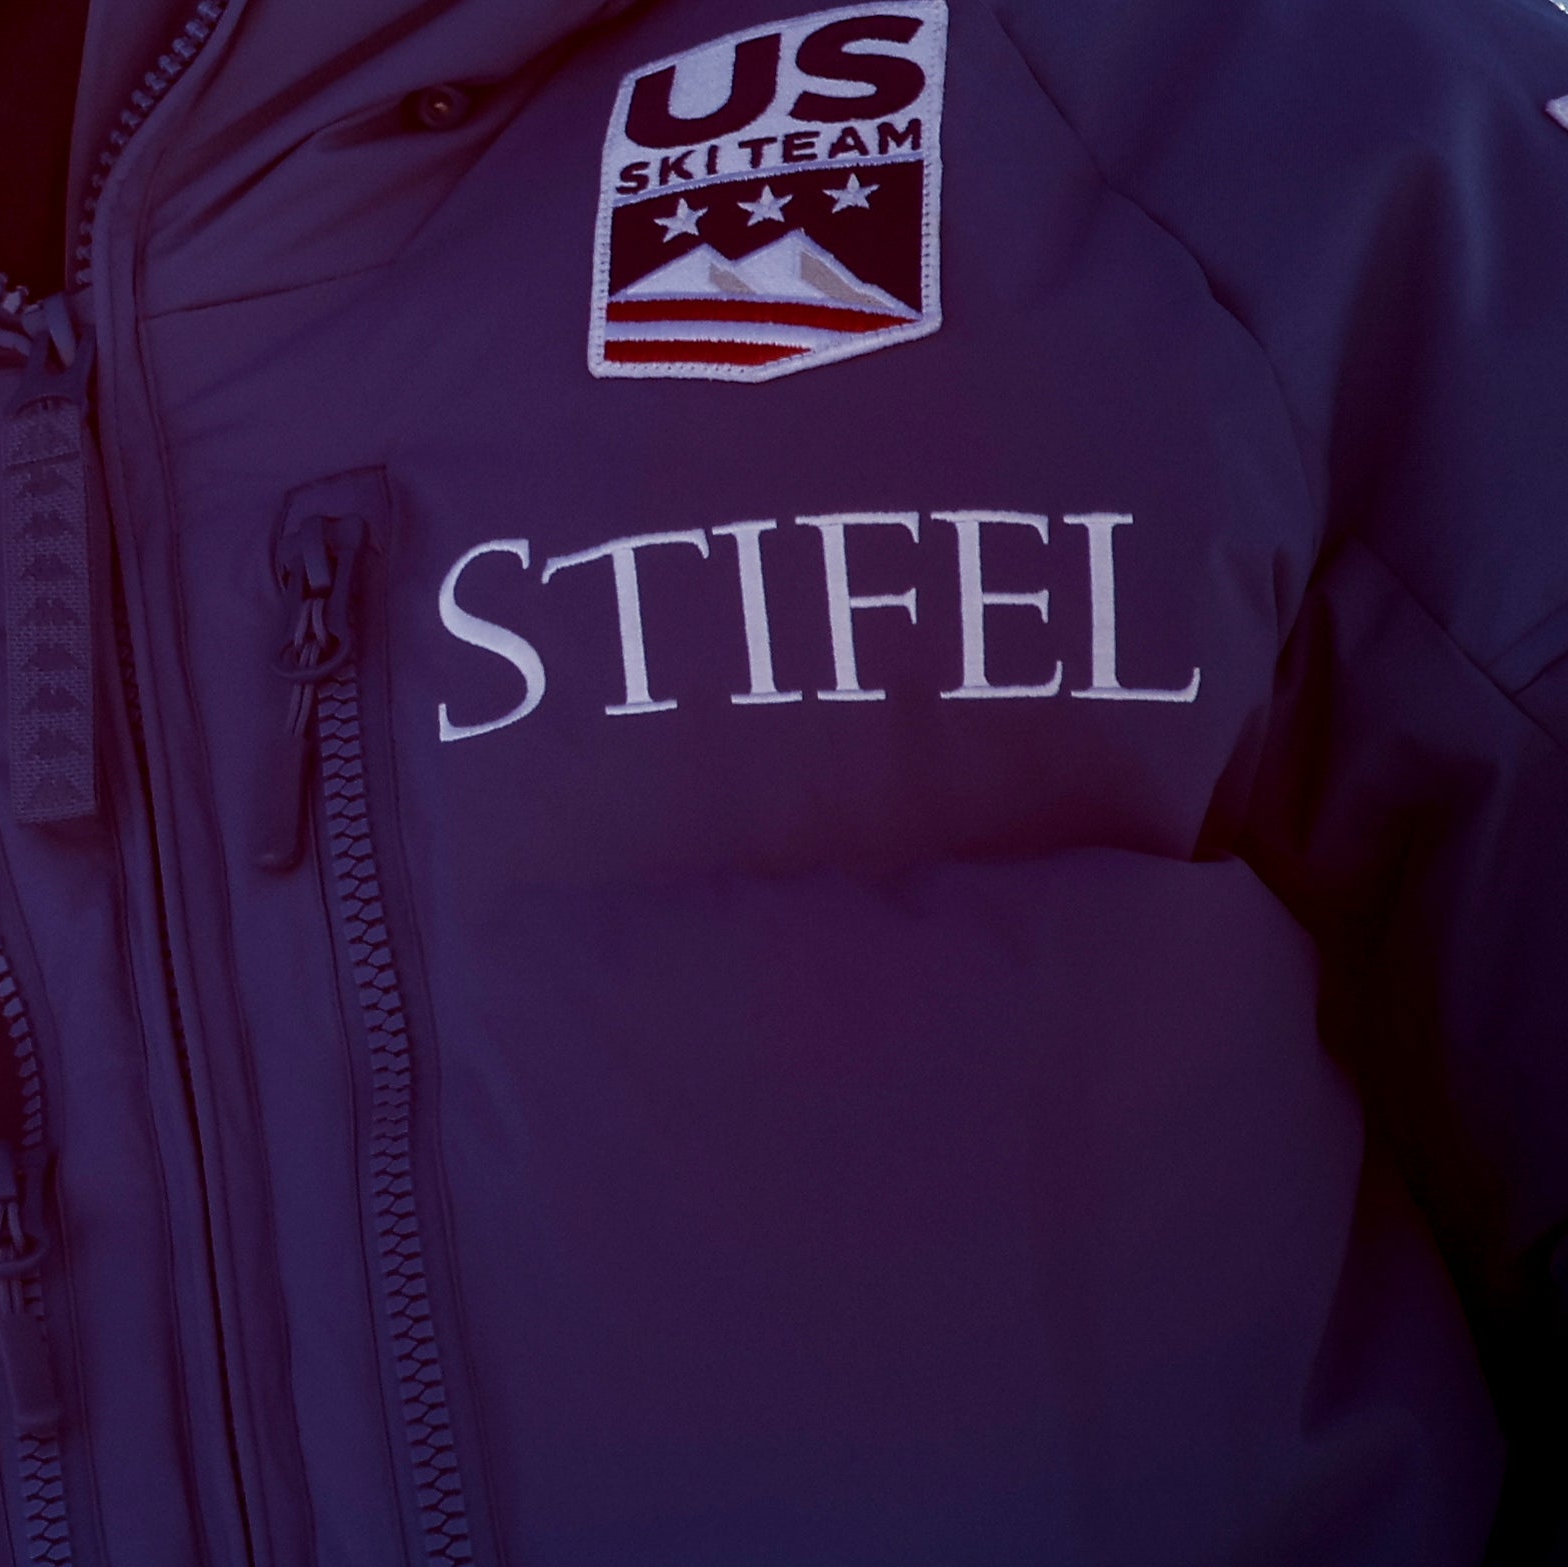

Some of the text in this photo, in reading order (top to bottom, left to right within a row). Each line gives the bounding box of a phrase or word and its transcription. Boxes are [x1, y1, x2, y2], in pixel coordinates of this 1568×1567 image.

[623, 13, 928, 149] US
[614, 117, 922, 195] SKI TEAM
[438, 510, 1201, 743] STIFEL
